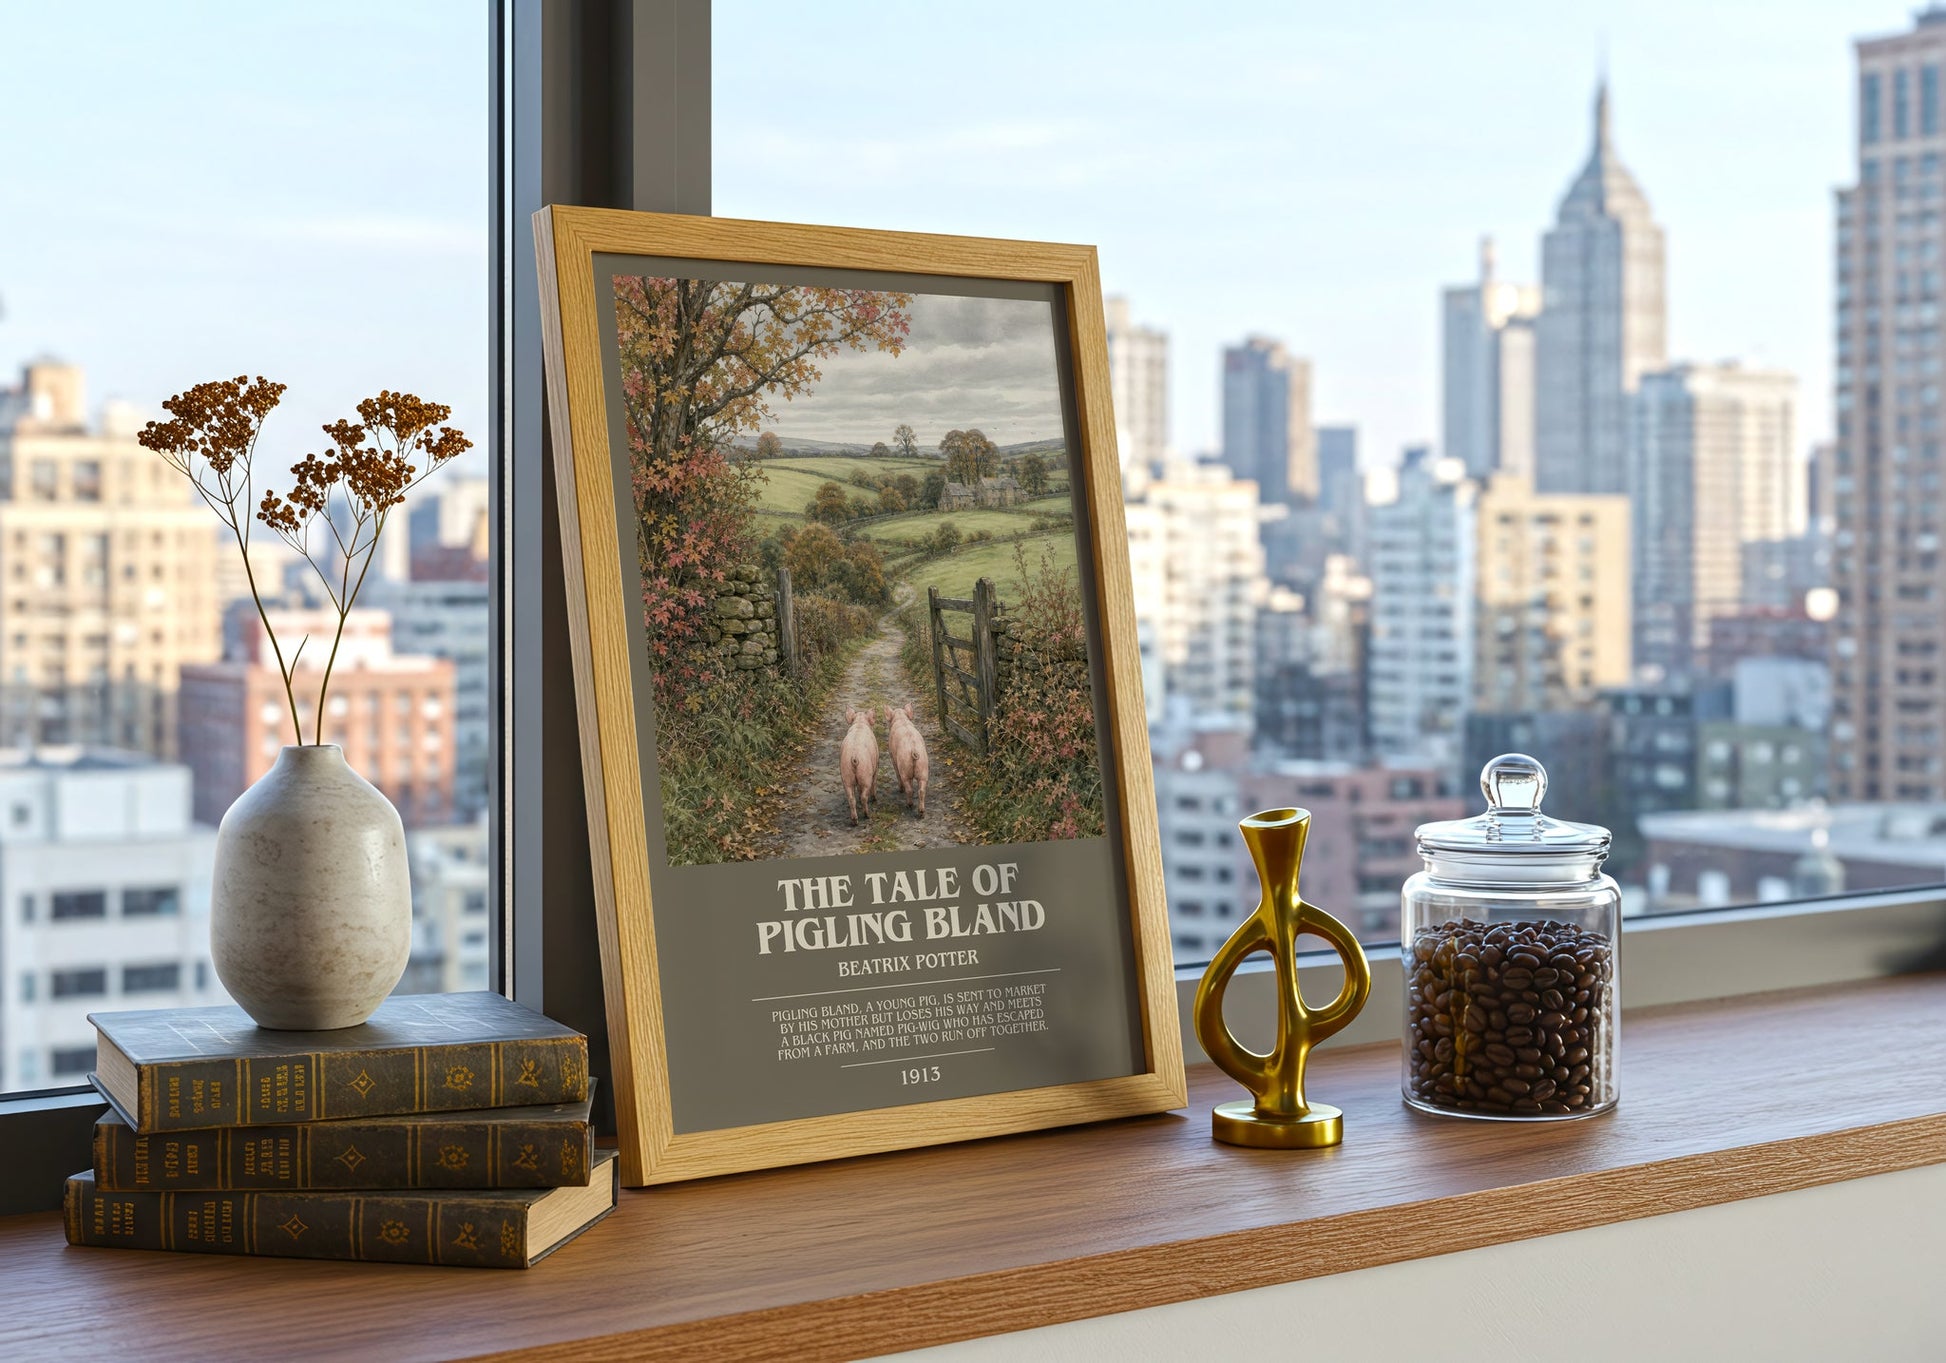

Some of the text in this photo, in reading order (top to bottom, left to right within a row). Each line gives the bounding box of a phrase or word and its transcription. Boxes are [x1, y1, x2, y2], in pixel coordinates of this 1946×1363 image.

[777, 863, 1018, 911] THE TALE OF
[756, 900, 1045, 955] PIGLING BLAND
[838, 949, 979, 977] BEATRIX POTTER
[772, 983, 1046, 1022] PIGLING BLAND, A YOUNG PIG, IS SENT TO MARKET
[780, 996, 1041, 1034] BY HIS MOTHER BUT LOSES HIS WAY AND MEETS
[778, 1020, 1049, 1061] FROM A FARM, AND THE TWO RUN OFF TOGETHER.
[781, 1008, 1044, 1047] A BLACK PIG NAMED PIG-WIG WHO HAS ESCAPED
[902, 1066, 940, 1085] 1913
